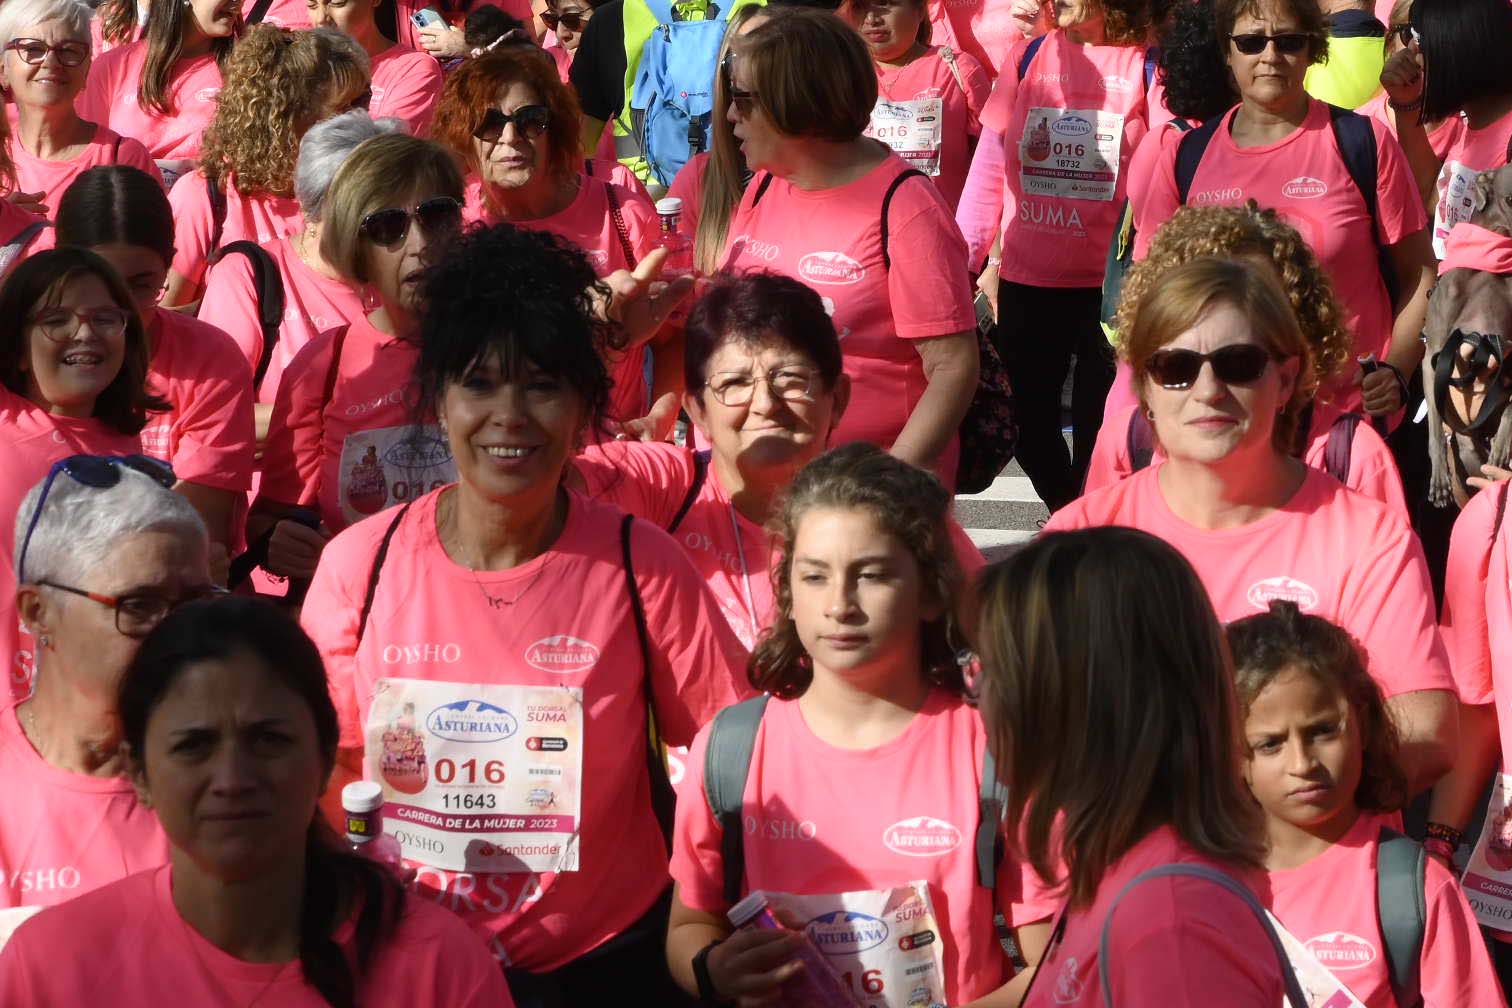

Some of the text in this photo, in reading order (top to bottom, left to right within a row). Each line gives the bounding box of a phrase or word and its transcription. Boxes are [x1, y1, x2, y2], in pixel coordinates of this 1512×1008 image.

[878, 125, 907, 137] 016
[1053, 142, 1085, 157] 016
[1056, 159, 1080, 168] 18732
[1196, 188, 1242, 202] OYSHO
[1021, 200, 1083, 229] SUMA
[384, 643, 460, 665] OYSHO
[532, 648, 594, 663] ASTURIANA
[432, 714, 510, 734] ASTURIANA
[526, 712, 567, 722] SUMA
[434, 758, 506, 785] 016
[442, 794, 496, 809] 11643
[397, 807, 557, 829] CARRERA DE LA MUJER 2023
[394, 830, 445, 854] OYSHO
[891, 831, 956, 847] ASTURIANA
[497, 845, 561, 856] Santander
